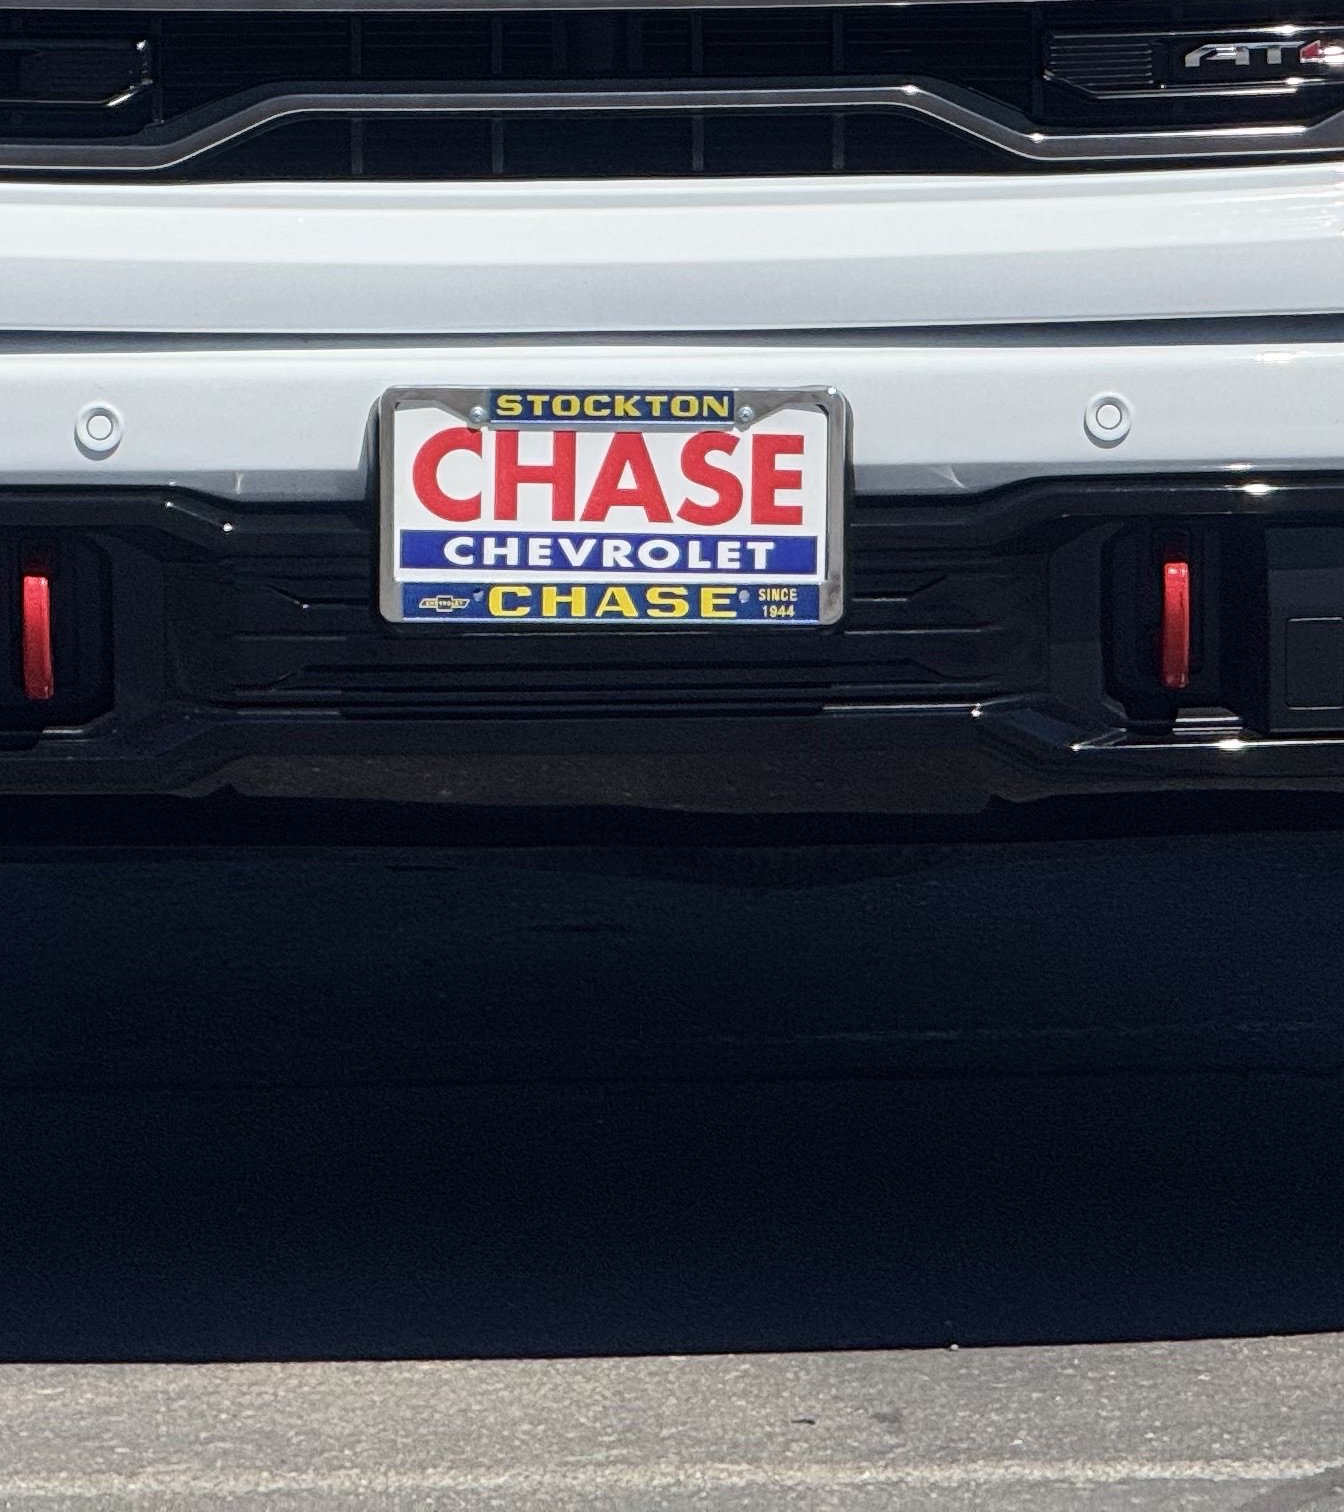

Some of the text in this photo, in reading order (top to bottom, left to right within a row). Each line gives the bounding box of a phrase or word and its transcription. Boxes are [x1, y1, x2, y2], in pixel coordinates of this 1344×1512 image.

[495, 393, 730, 418] STOCKTON
[412, 426, 805, 526] CHASE
[443, 535, 775, 571] CHEVROLET
[488, 585, 738, 618] CHASE
[758, 588, 798, 602] SINCE
[762, 604, 795, 618] 1944
